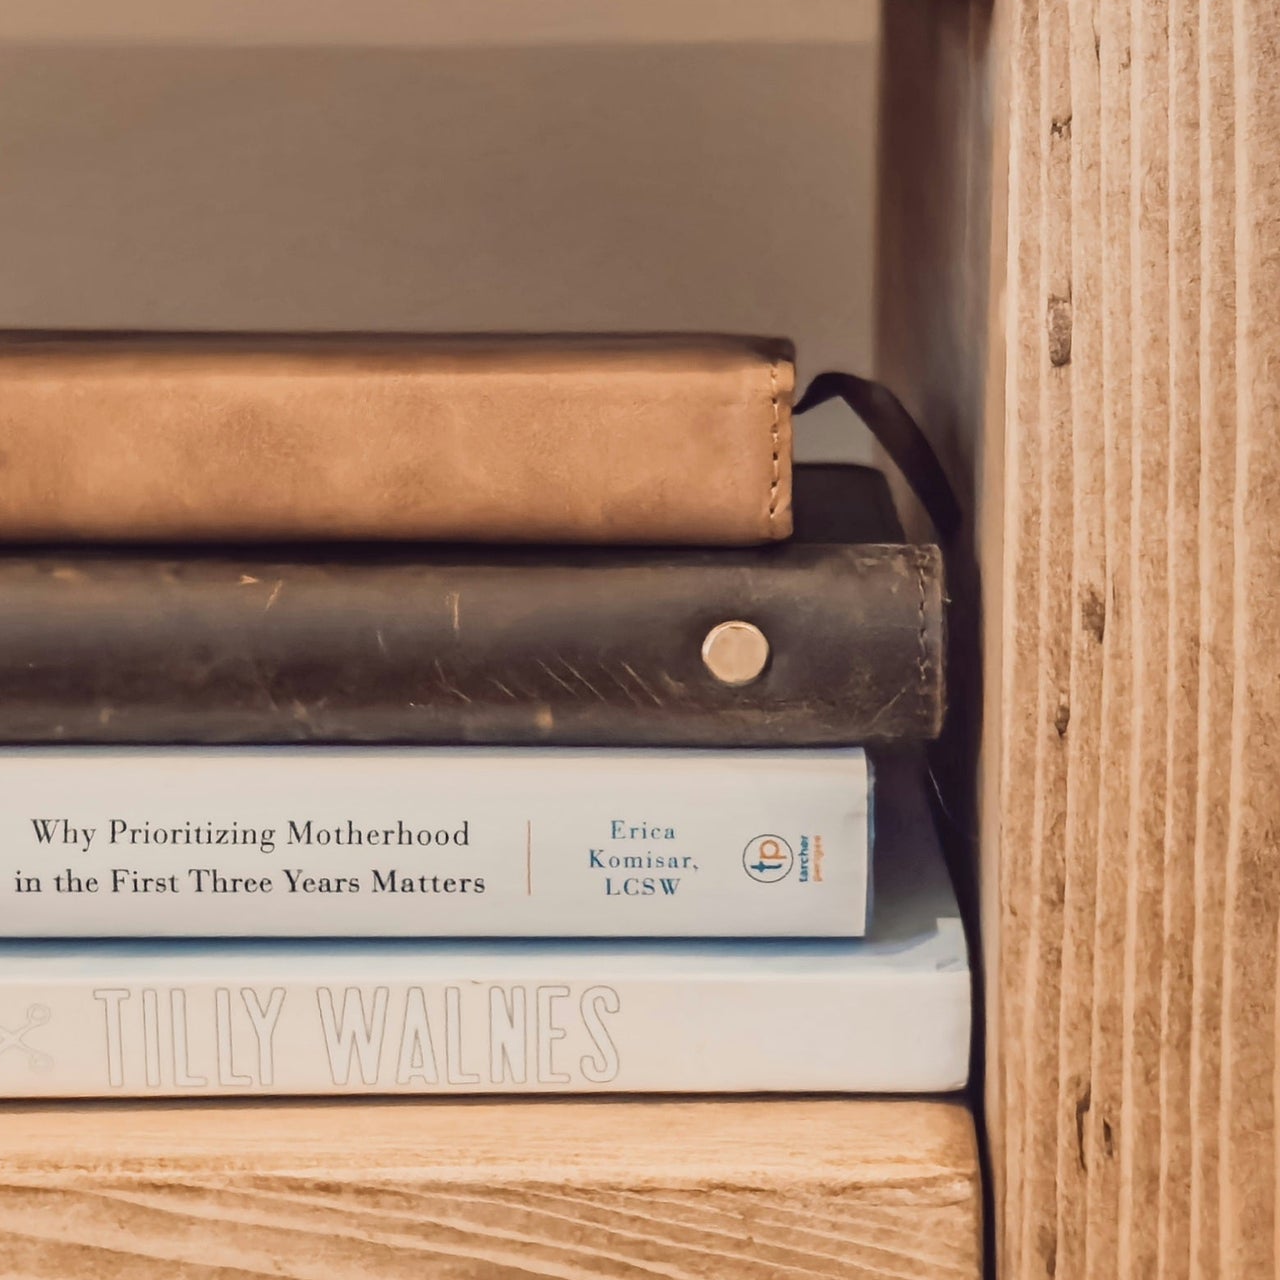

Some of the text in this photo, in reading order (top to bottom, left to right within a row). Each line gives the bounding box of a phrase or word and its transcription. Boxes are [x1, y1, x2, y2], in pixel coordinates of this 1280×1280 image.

[30, 818, 470, 853] Why Prioritizing Motherhood
[611, 820, 675, 839] Erica
[589, 849, 699, 870] Komisar,
[15, 869, 486, 894] in the First Three Years Matters
[605, 878, 680, 895] LCSW
[93, 986, 287, 1088] TILLY
[316, 985, 621, 1085] WALNES
